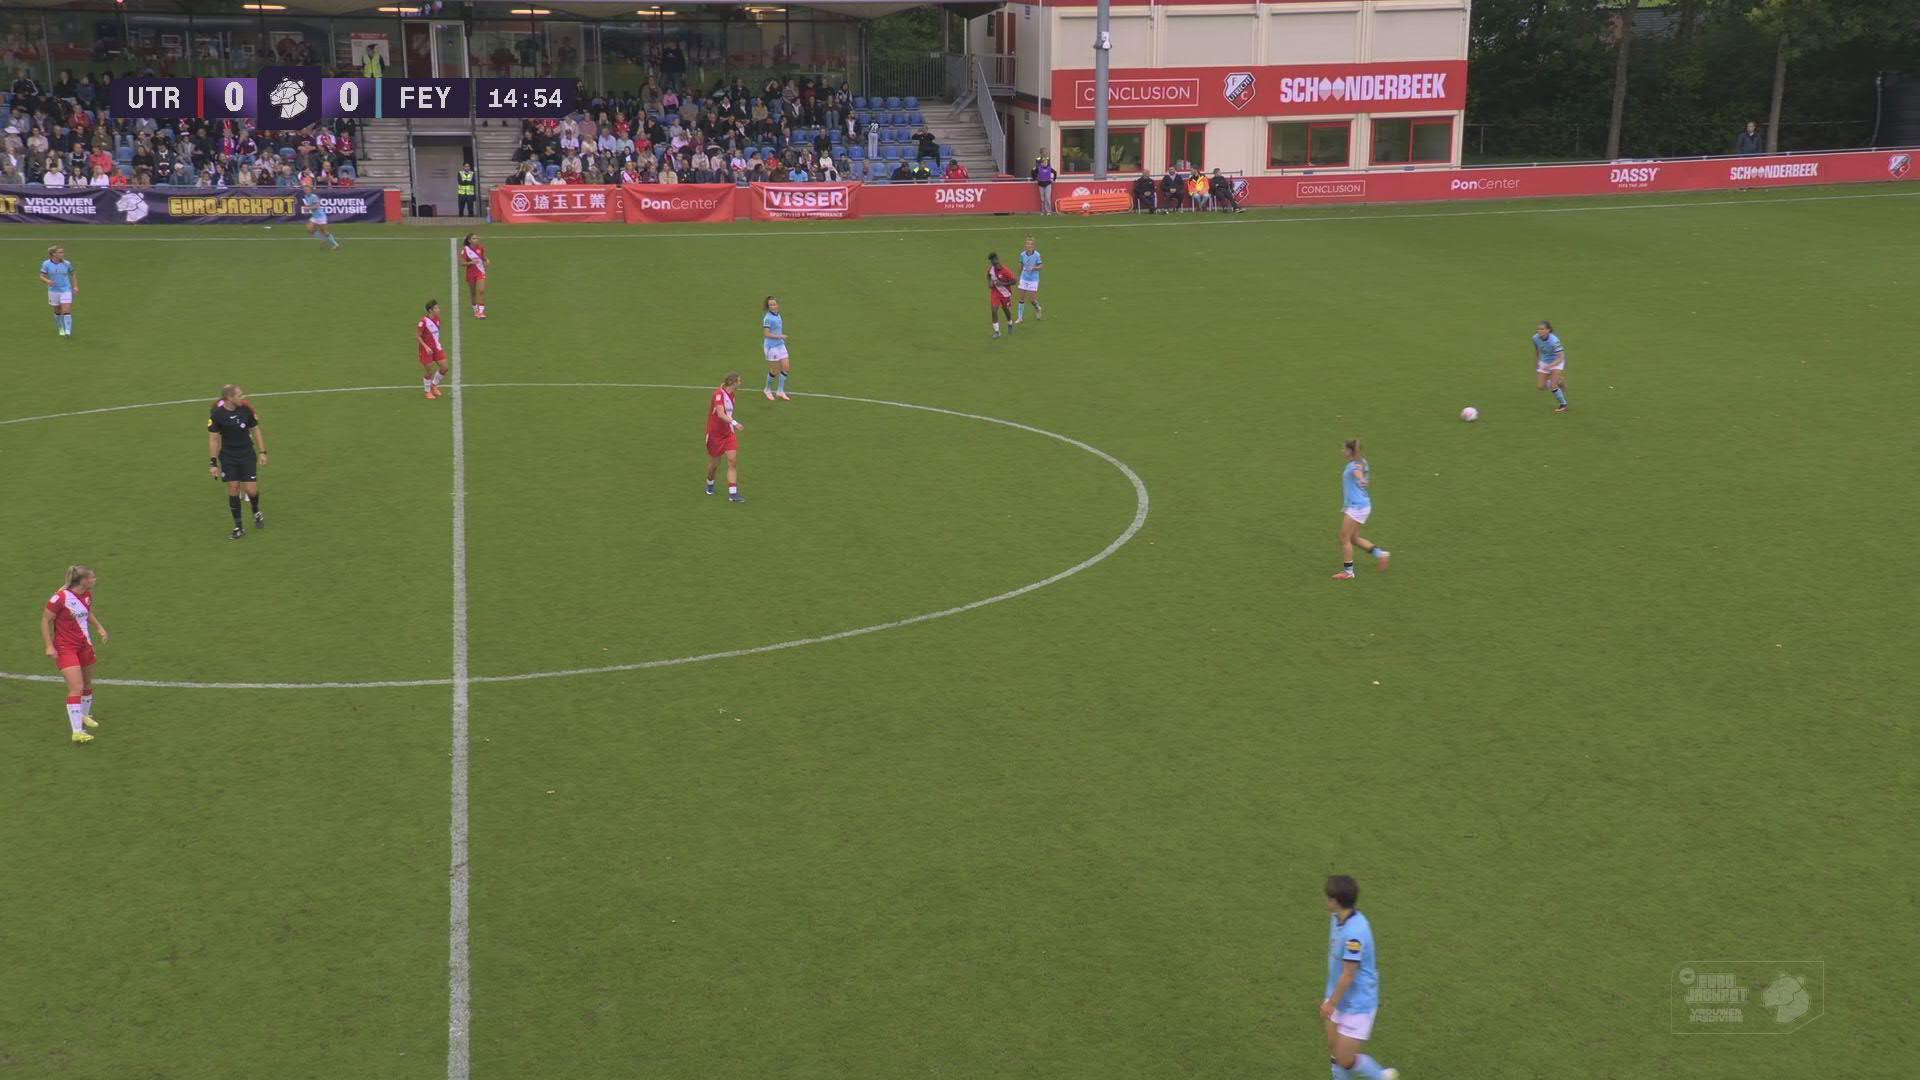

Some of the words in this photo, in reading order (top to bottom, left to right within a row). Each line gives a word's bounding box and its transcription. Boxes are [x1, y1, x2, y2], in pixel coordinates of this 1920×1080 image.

[1084, 86, 1190, 101] CNCLUSION
[1610, 167, 1658, 183] DASSY
[935, 188, 984, 203] DASSY
[1301, 184, 1361, 194] CONCLUSION
[25, 197, 93, 206] VROUWEN
[769, 190, 843, 208] VISSER
[24, 205, 96, 215] EREDIVISIE
[169, 198, 296, 216] EUROJACKPOT
